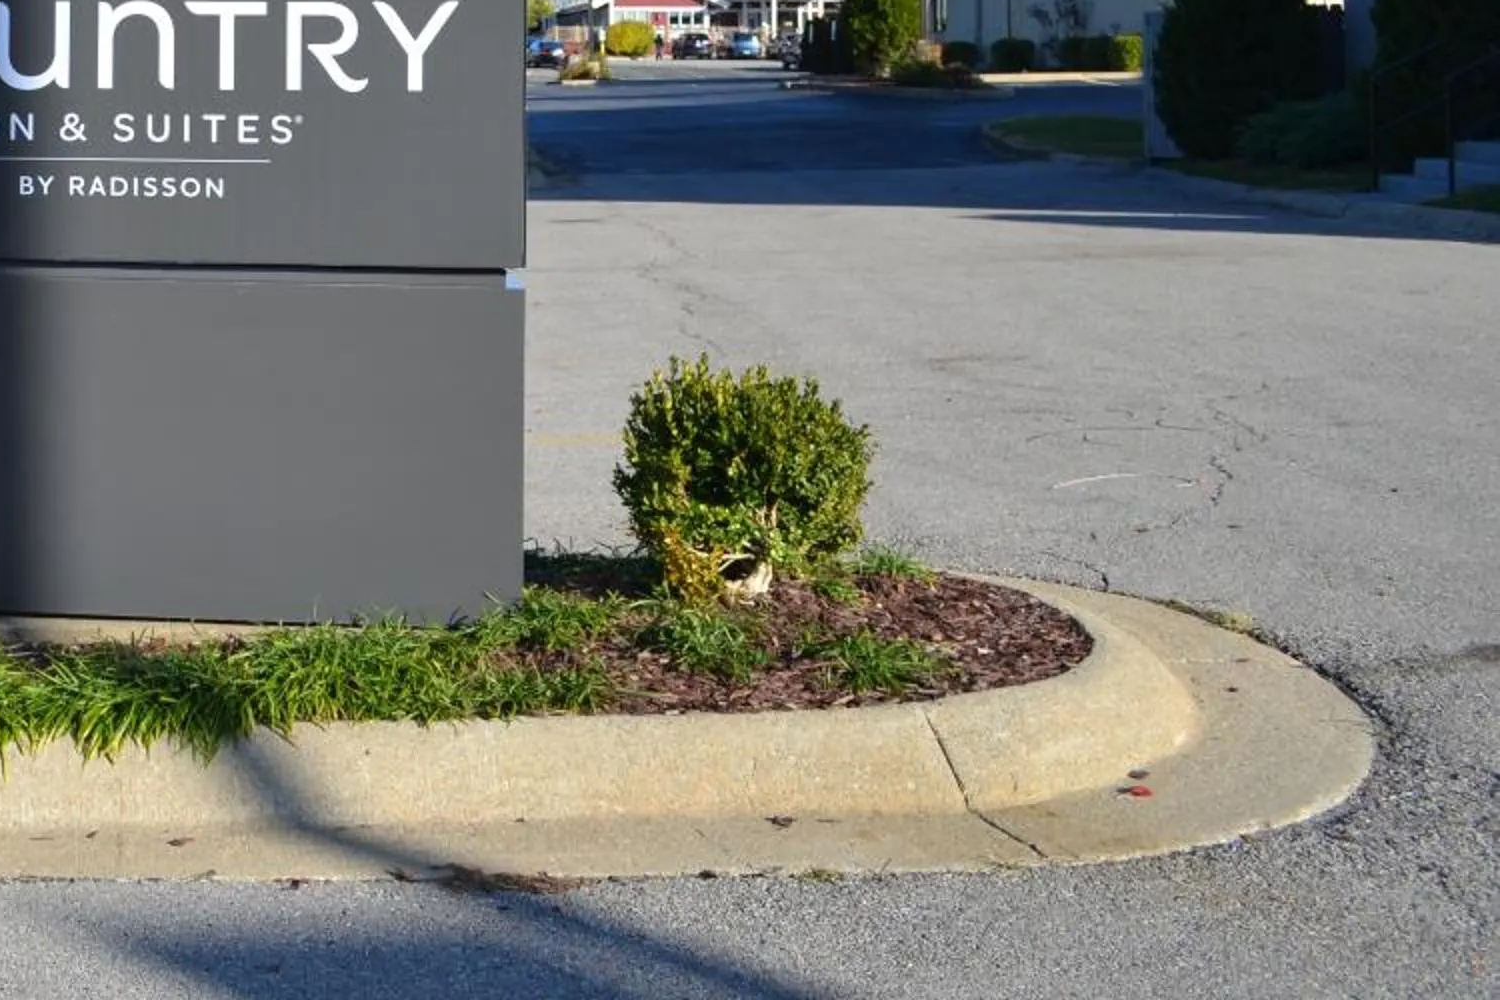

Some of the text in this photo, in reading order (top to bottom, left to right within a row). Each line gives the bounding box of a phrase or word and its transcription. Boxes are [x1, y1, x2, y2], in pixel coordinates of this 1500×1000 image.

[59, 112, 89, 143] &
[18, 174, 226, 200] BY RADISSON
